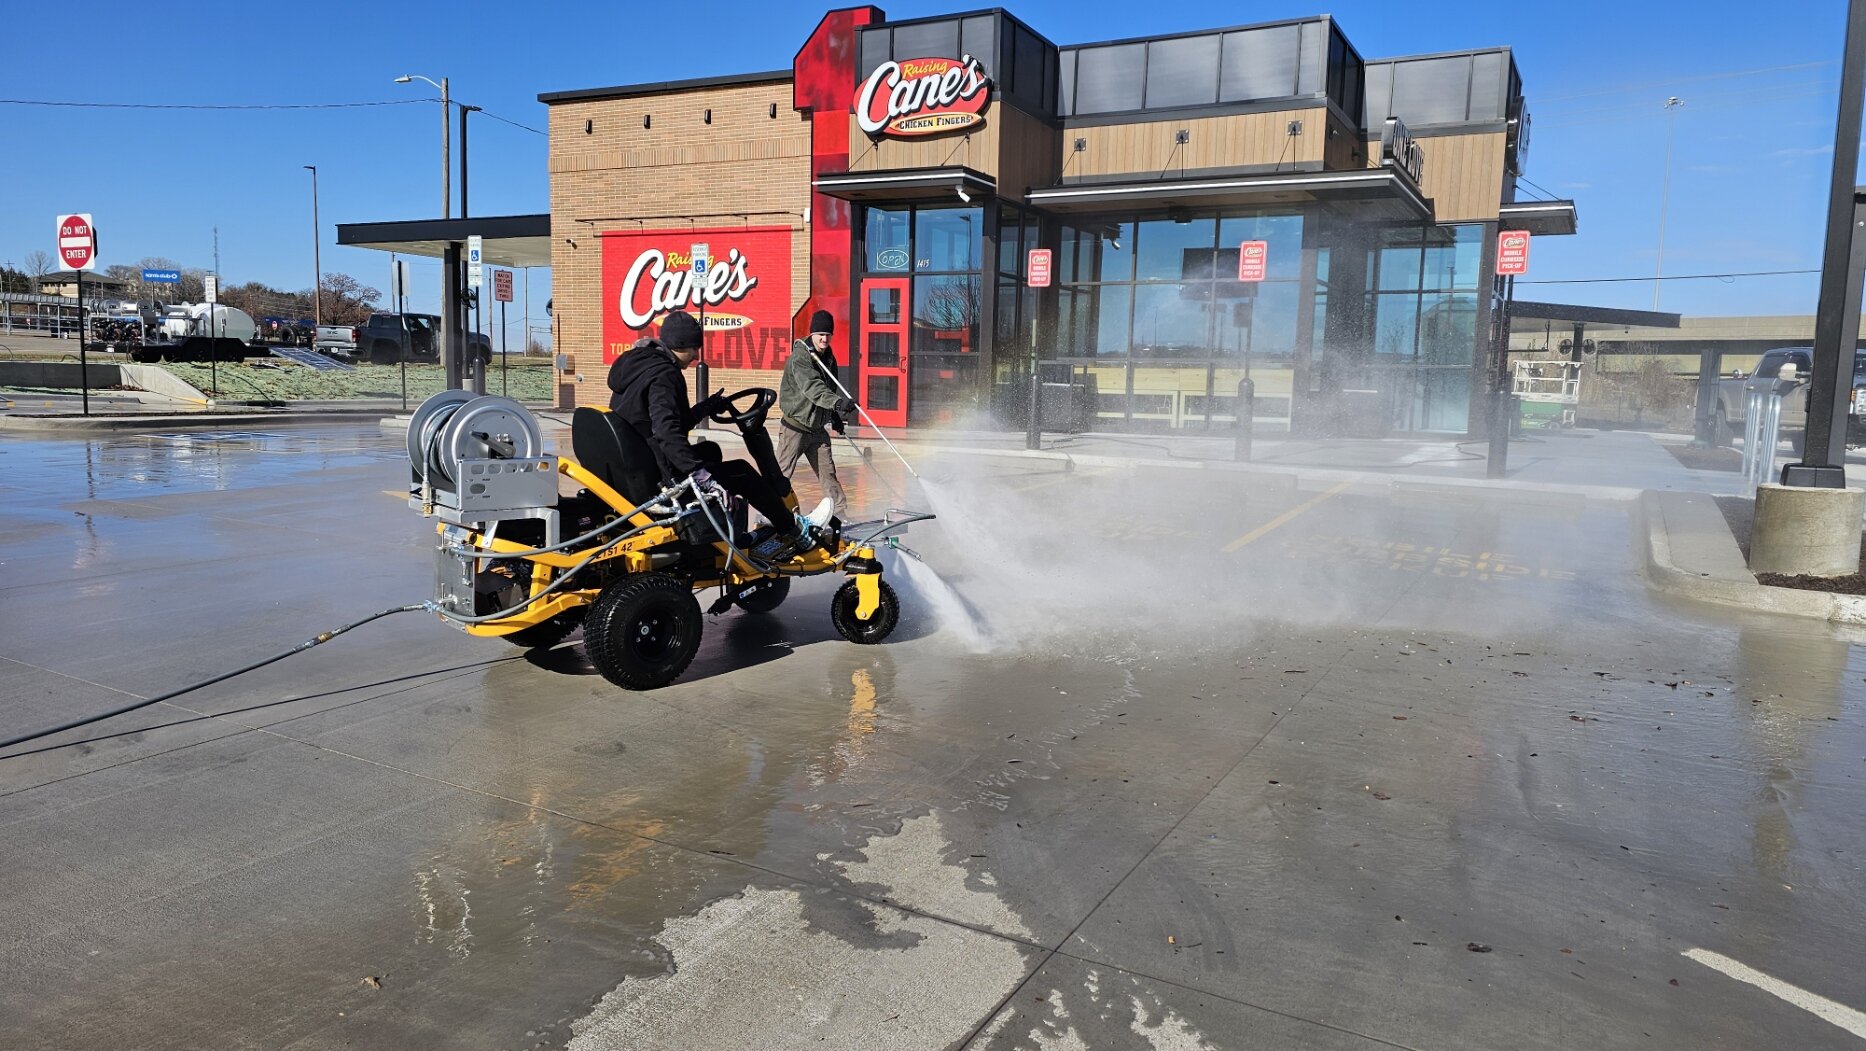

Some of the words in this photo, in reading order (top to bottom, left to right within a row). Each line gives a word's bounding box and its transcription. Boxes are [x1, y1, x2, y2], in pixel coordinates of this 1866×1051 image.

[903, 61, 948, 79] Raising
[857, 54, 988, 134] Cane's
[899, 119, 934, 130] CHICKEN
[936, 115, 971, 127] FINGERS
[62, 227, 72, 235] DO
[75, 226, 87, 235] NOT
[66, 250, 87, 259] ENTER
[704, 316, 742, 327] FINGERS
